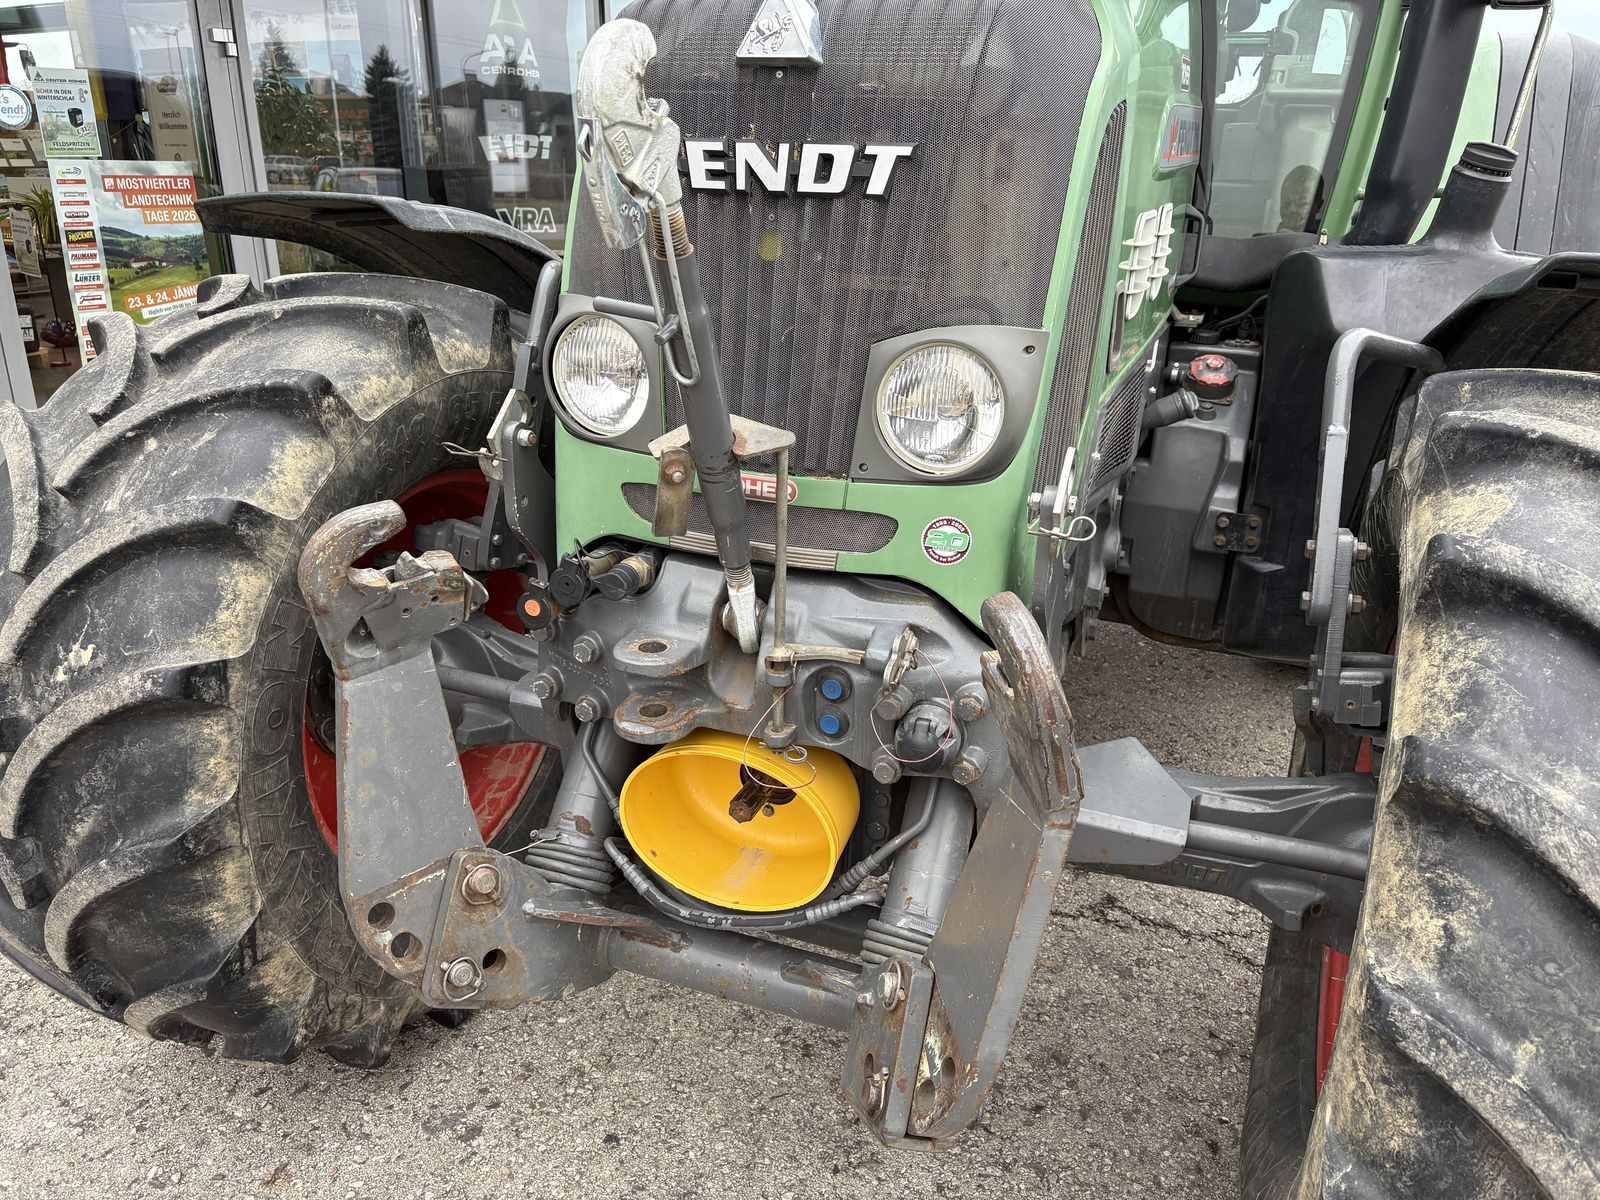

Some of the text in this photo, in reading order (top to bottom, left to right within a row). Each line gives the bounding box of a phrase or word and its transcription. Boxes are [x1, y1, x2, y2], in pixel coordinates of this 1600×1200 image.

[161, 110, 182, 119] Herzlich
[157, 121, 189, 130] Willkommen
[684, 138, 918, 198] ENDT
[116, 178, 191, 190] MOSTVIERTLER
[125, 194, 194, 206] LANDTECHNIK
[145, 210, 197, 222] TAGE 2026
[127, 285, 198, 308] 23. & 24. JÄNN
[925, 530, 969, 552] 20
[250, 598, 384, 988] RAXION
